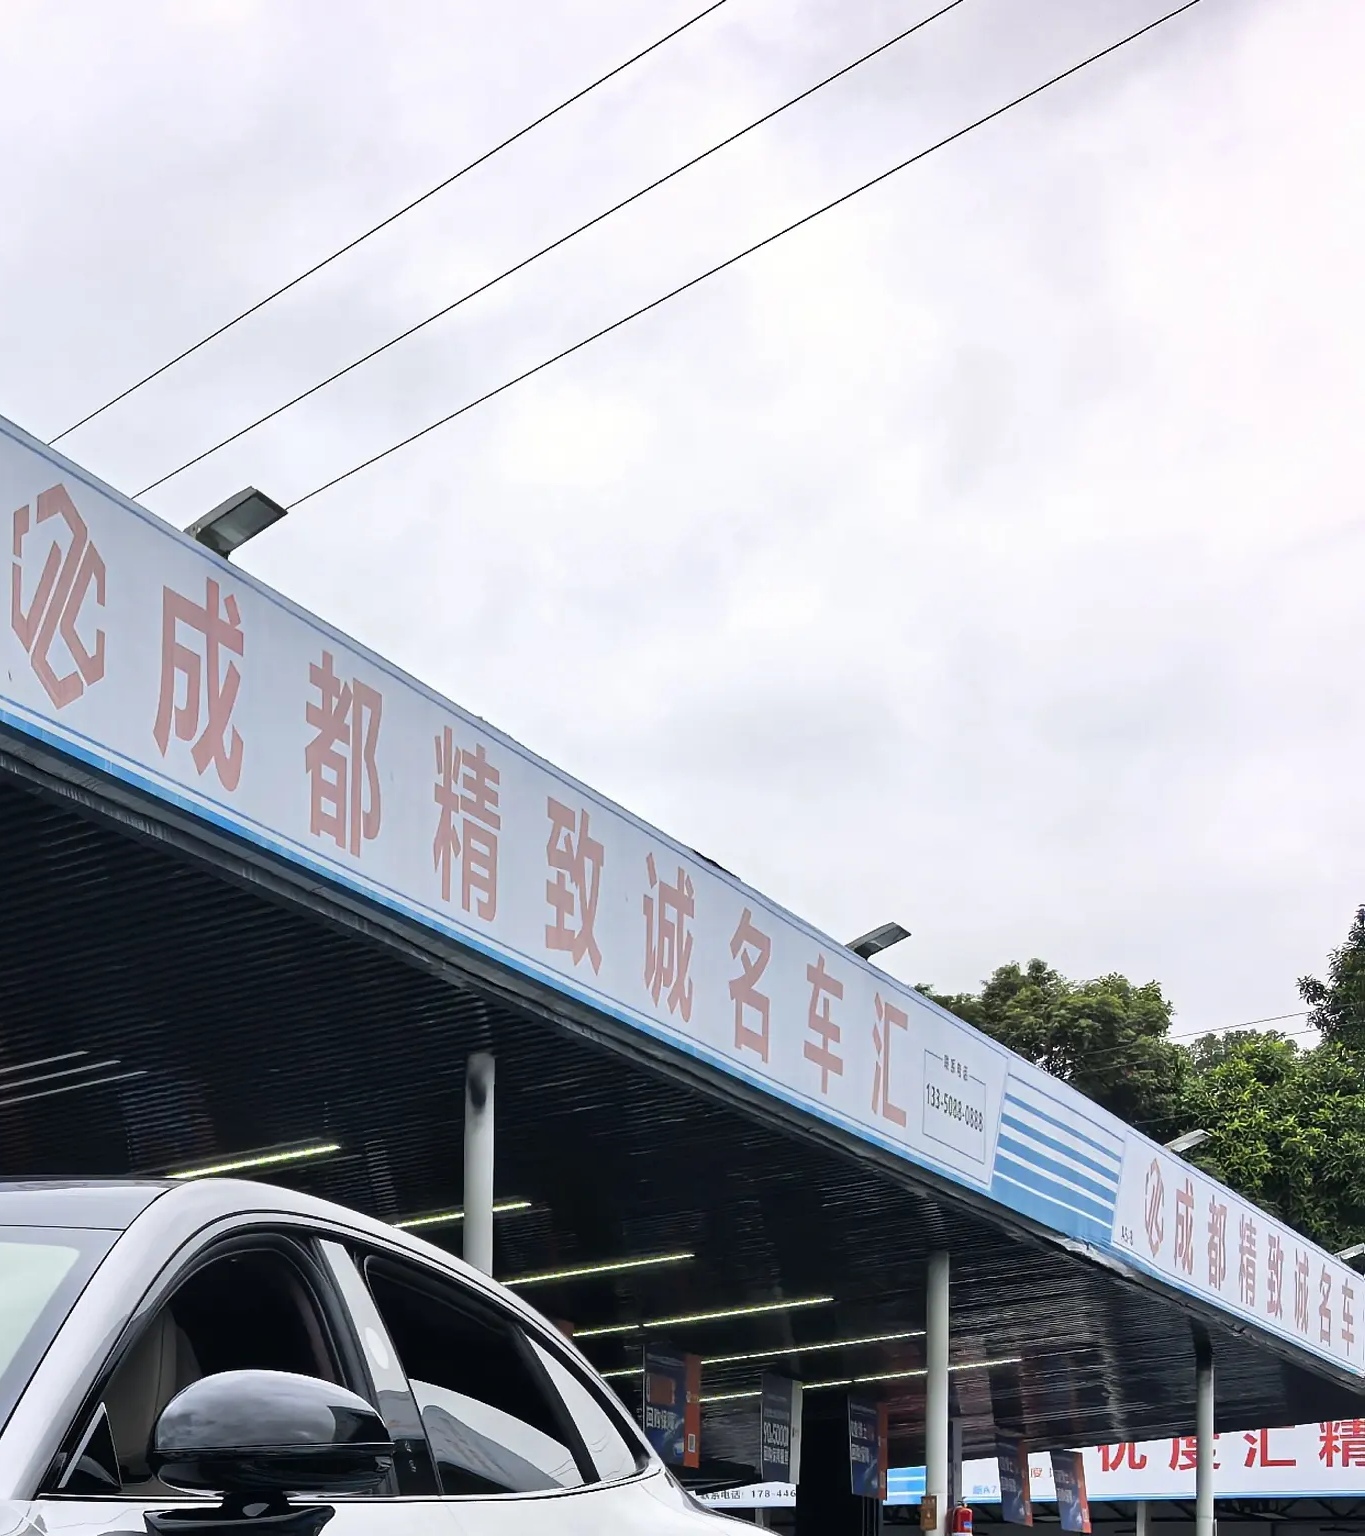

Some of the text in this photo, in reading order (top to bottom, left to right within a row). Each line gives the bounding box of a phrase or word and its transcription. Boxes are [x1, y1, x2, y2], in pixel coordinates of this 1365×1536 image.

[153, 577, 909, 1129] 成都精致诚名车汇
